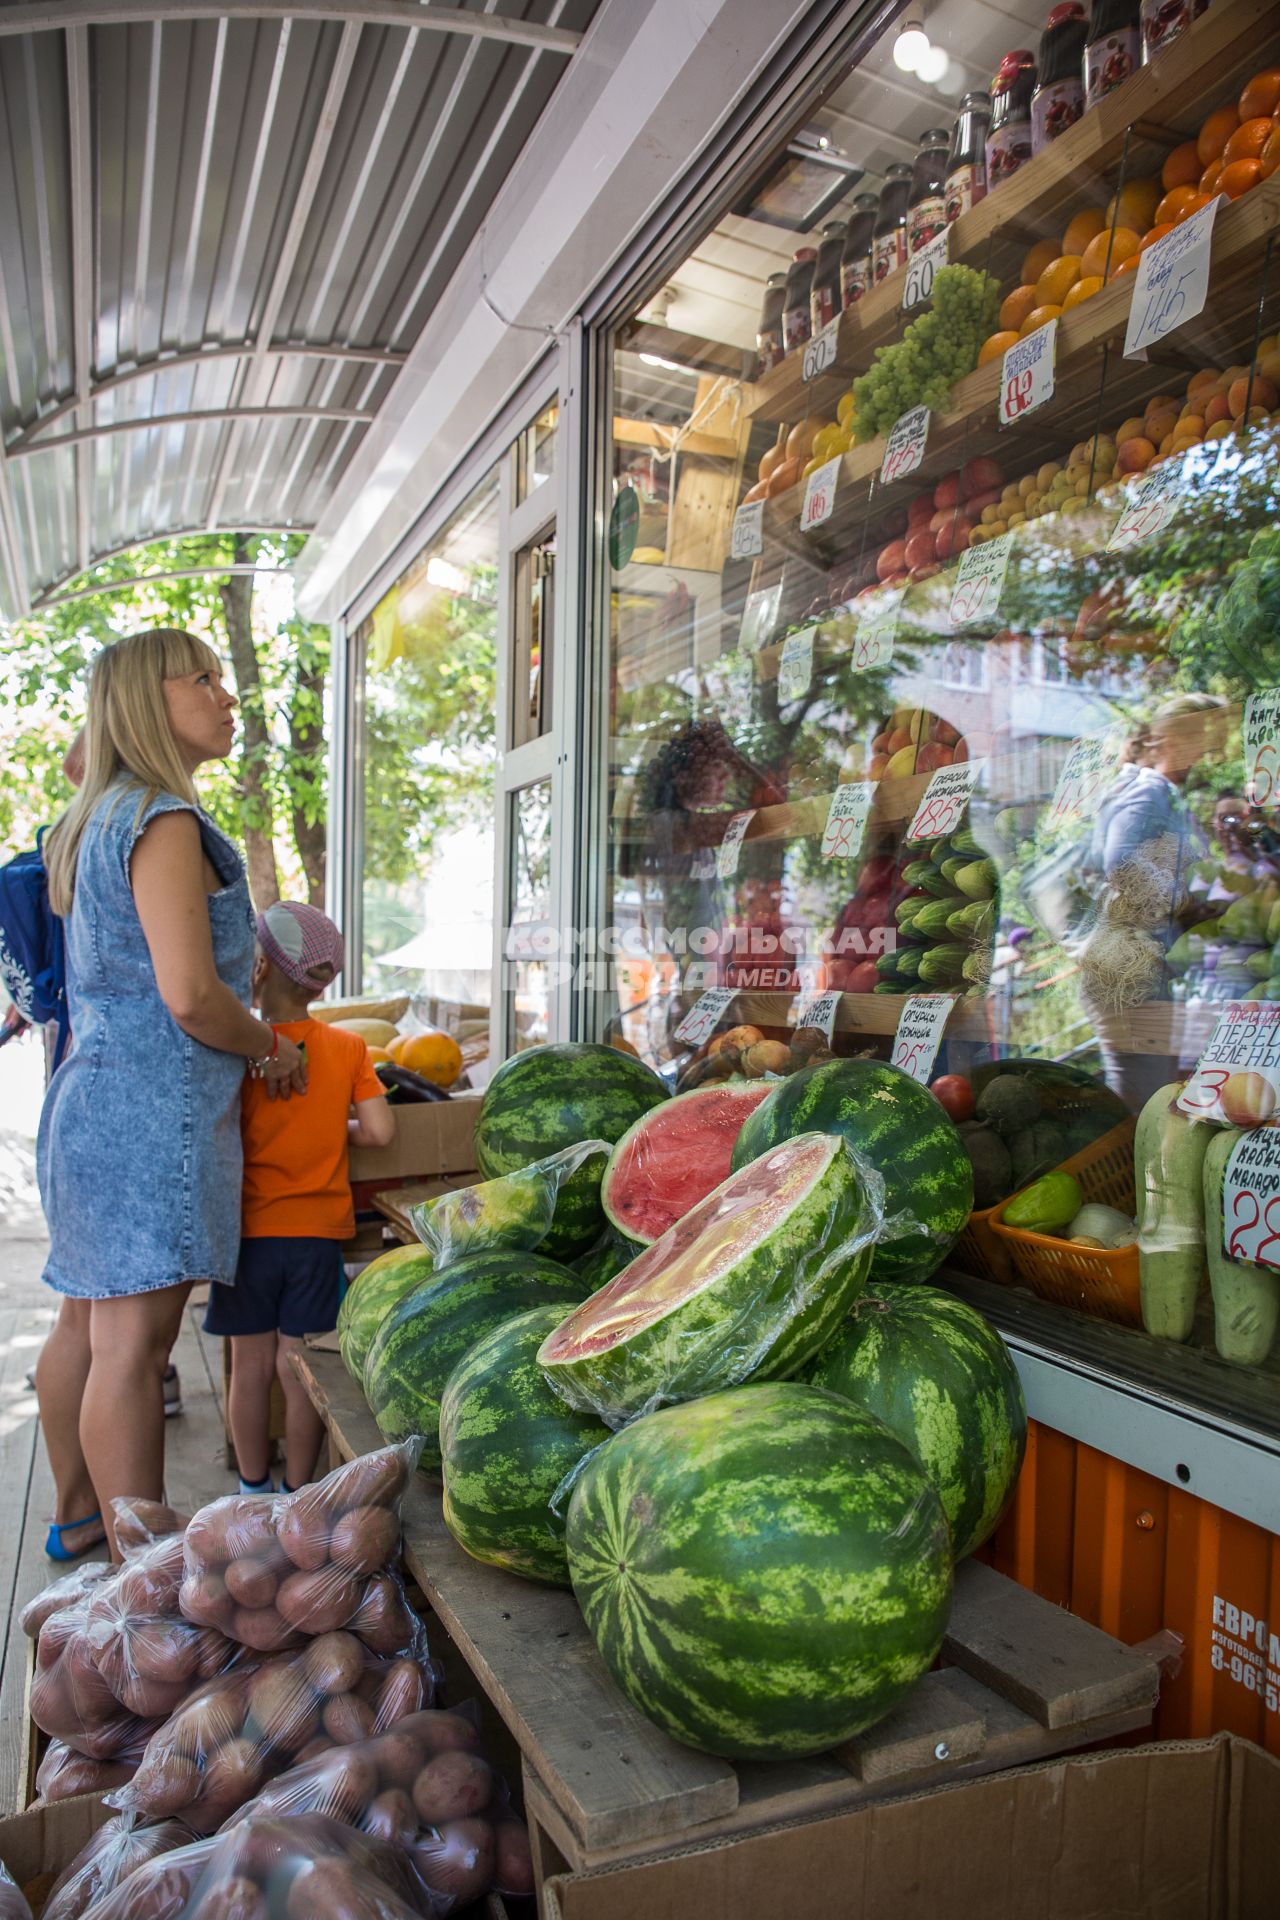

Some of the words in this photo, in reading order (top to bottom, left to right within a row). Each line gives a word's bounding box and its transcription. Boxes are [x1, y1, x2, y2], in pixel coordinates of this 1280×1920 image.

[906, 260, 934, 308] 60
[1132, 267, 1198, 348] 145
[1005, 369, 1033, 417] 82
[1106, 495, 1168, 552] 85
[951, 576, 988, 622] 60
[1251, 744, 1280, 807] 6
[821, 817, 855, 859] 98
[910, 797, 961, 839] 185
[679, 1010, 712, 1041] 45
